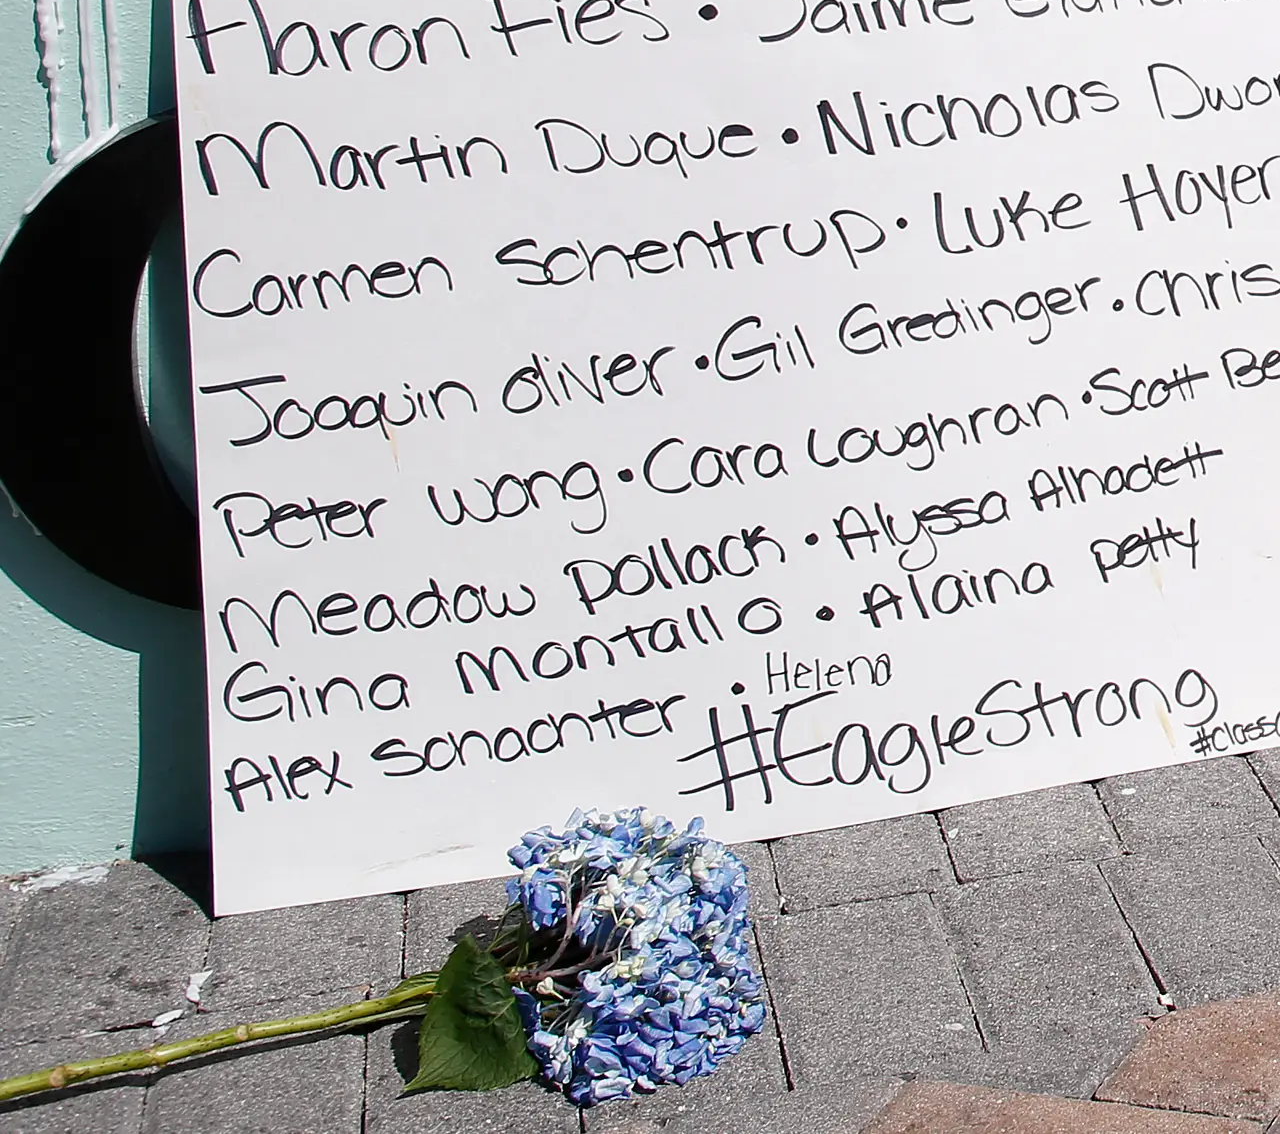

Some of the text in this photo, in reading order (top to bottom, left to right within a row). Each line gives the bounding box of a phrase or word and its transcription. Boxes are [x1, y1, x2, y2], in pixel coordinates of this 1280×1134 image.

[196, 122, 507, 195] Martin
[535, 119, 755, 178] Duque
[817, 81, 1119, 155] Nicholas
[193, 249, 452, 317] Carmen
[934, 191, 1089, 253] Luke
[715, 316, 814, 380] Gil
[213, 492, 386, 557] Peter
[644, 438, 788, 493] Cara
[808, 394, 1068, 471] Loughran
[1090, 364, 1208, 415] Scott
[219, 579, 535, 653] Meadow
[833, 491, 1009, 571] Alyssa
[224, 662, 409, 721] Gina
[860, 563, 1053, 628] Alaina
[225, 751, 352, 812] Alex
[767, 652, 891, 694] Helena
[678, 666, 1219, 811] #EagleStrong
